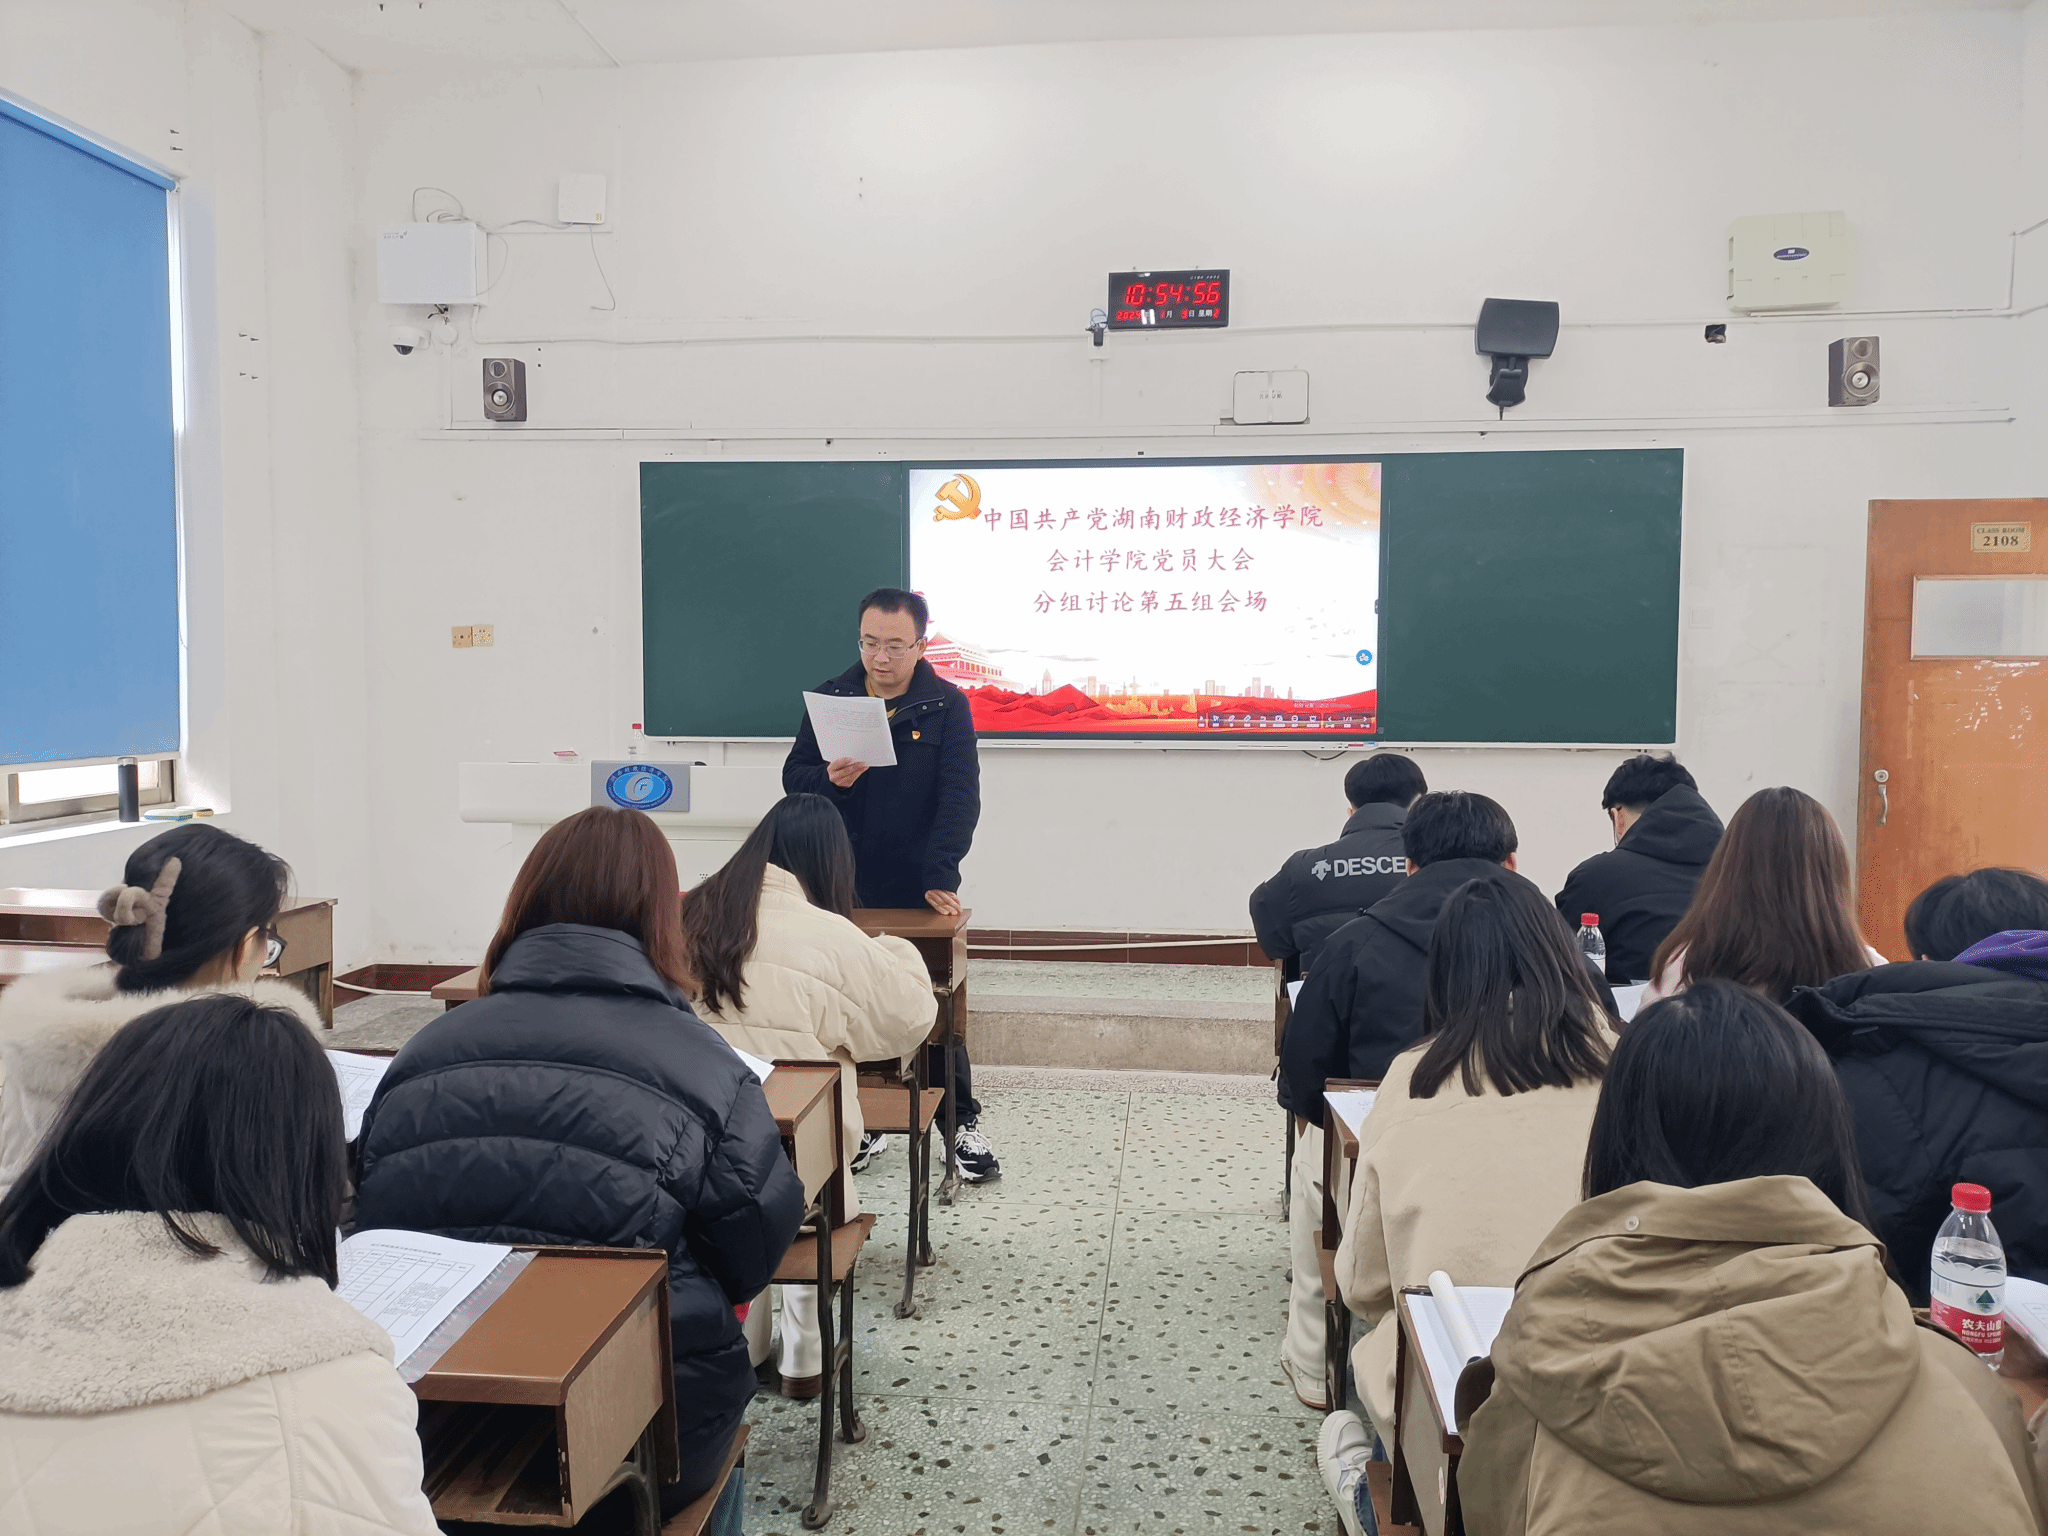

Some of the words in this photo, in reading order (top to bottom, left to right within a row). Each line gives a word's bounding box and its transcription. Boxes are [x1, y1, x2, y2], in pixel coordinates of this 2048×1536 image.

[1124, 281, 1221, 307] 10:54:56
[984, 504, 1323, 532] 中国共产党湖南财政经济学院
[1983, 535, 2019, 547] 2108
[1046, 547, 1255, 573] 会计学院党员大会
[1033, 589, 1268, 614] 分组讨论第五组会场
[1961, 1330, 1986, 1338] NONGFU
